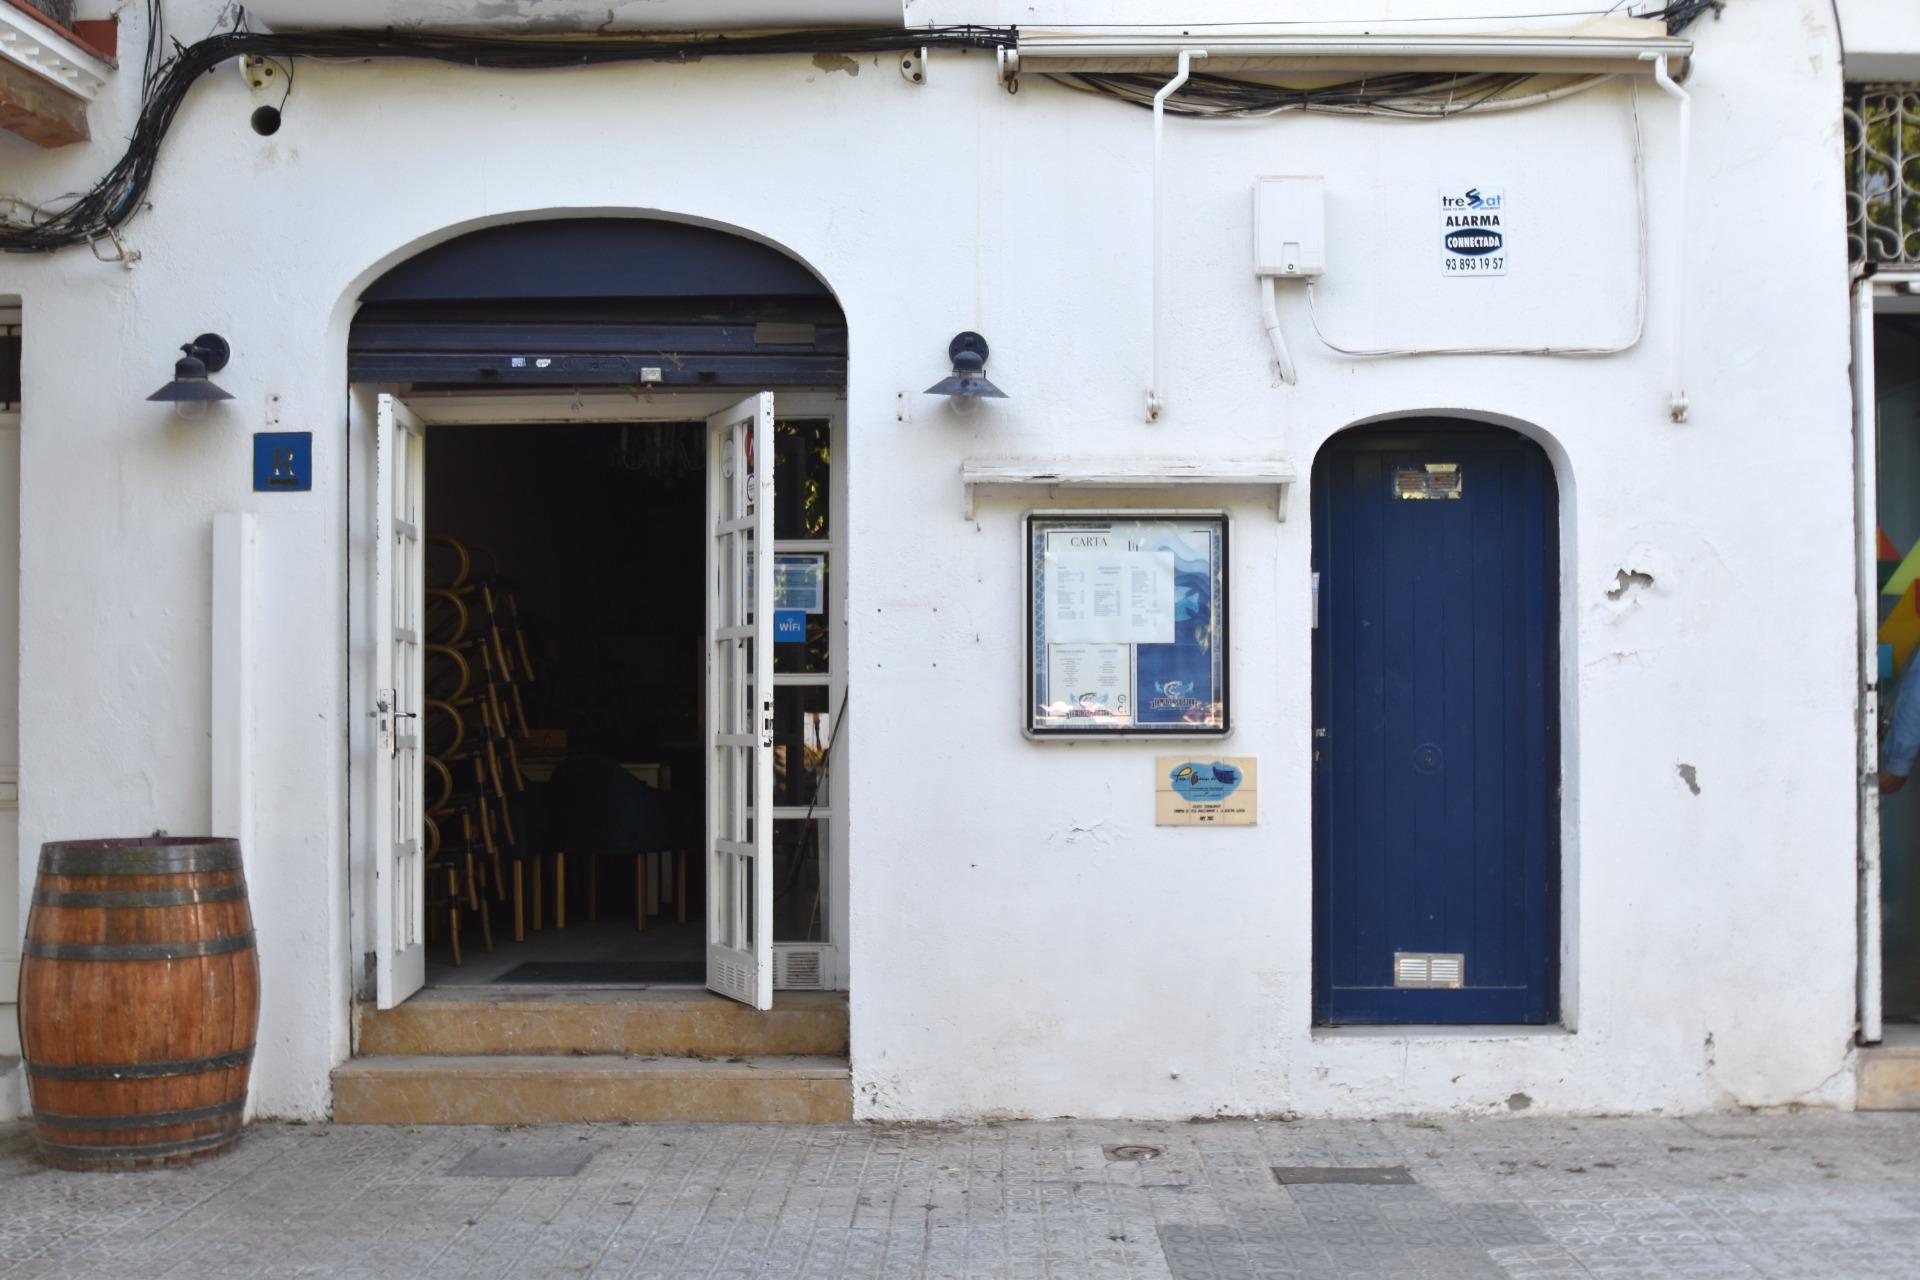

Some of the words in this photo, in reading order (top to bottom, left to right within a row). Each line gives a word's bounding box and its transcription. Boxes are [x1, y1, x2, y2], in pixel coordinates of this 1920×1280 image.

[1446, 215, 1500, 227] ALARMA
[1447, 236, 1500, 248] CONNECTADA
[1445, 258, 1457, 270] 93
[1459, 258, 1476, 270] 893
[1479, 258, 1490, 270] 19
[1492, 257, 1503, 269] 57
[1070, 537, 1108, 547] CARTA
